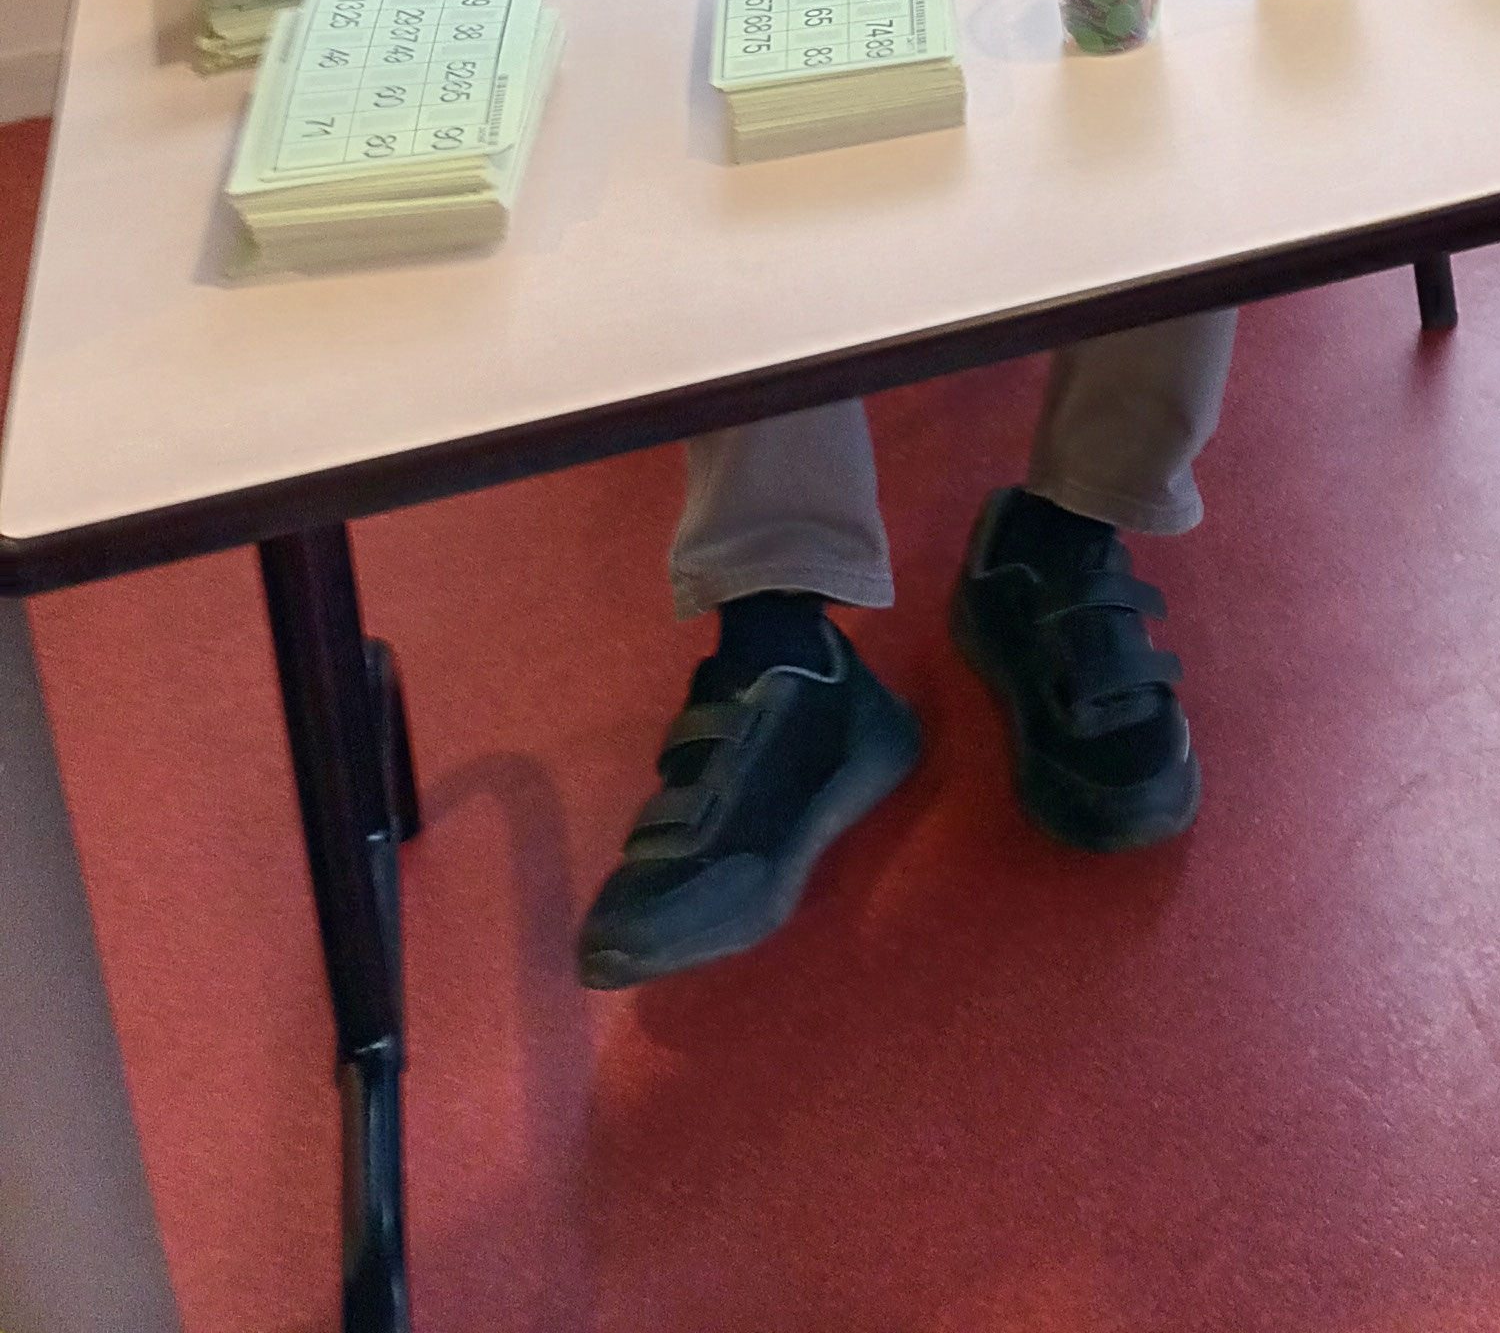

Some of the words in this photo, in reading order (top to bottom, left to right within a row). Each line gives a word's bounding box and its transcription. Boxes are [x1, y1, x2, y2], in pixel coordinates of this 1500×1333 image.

[329, 12, 362, 29] 25
[743, 14, 772, 34] 68
[804, 8, 833, 27] 65
[390, 26, 421, 43] 37
[452, 23, 485, 41] 38
[865, 19, 894, 37] 74
[742, 34, 771, 54] 75
[865, 38, 894, 59] 89
[803, 47, 833, 67] 83
[444, 61, 477, 81] 52
[439, 81, 473, 103] 65
[302, 117, 335, 138] 71
[431, 126, 465, 151] 90
